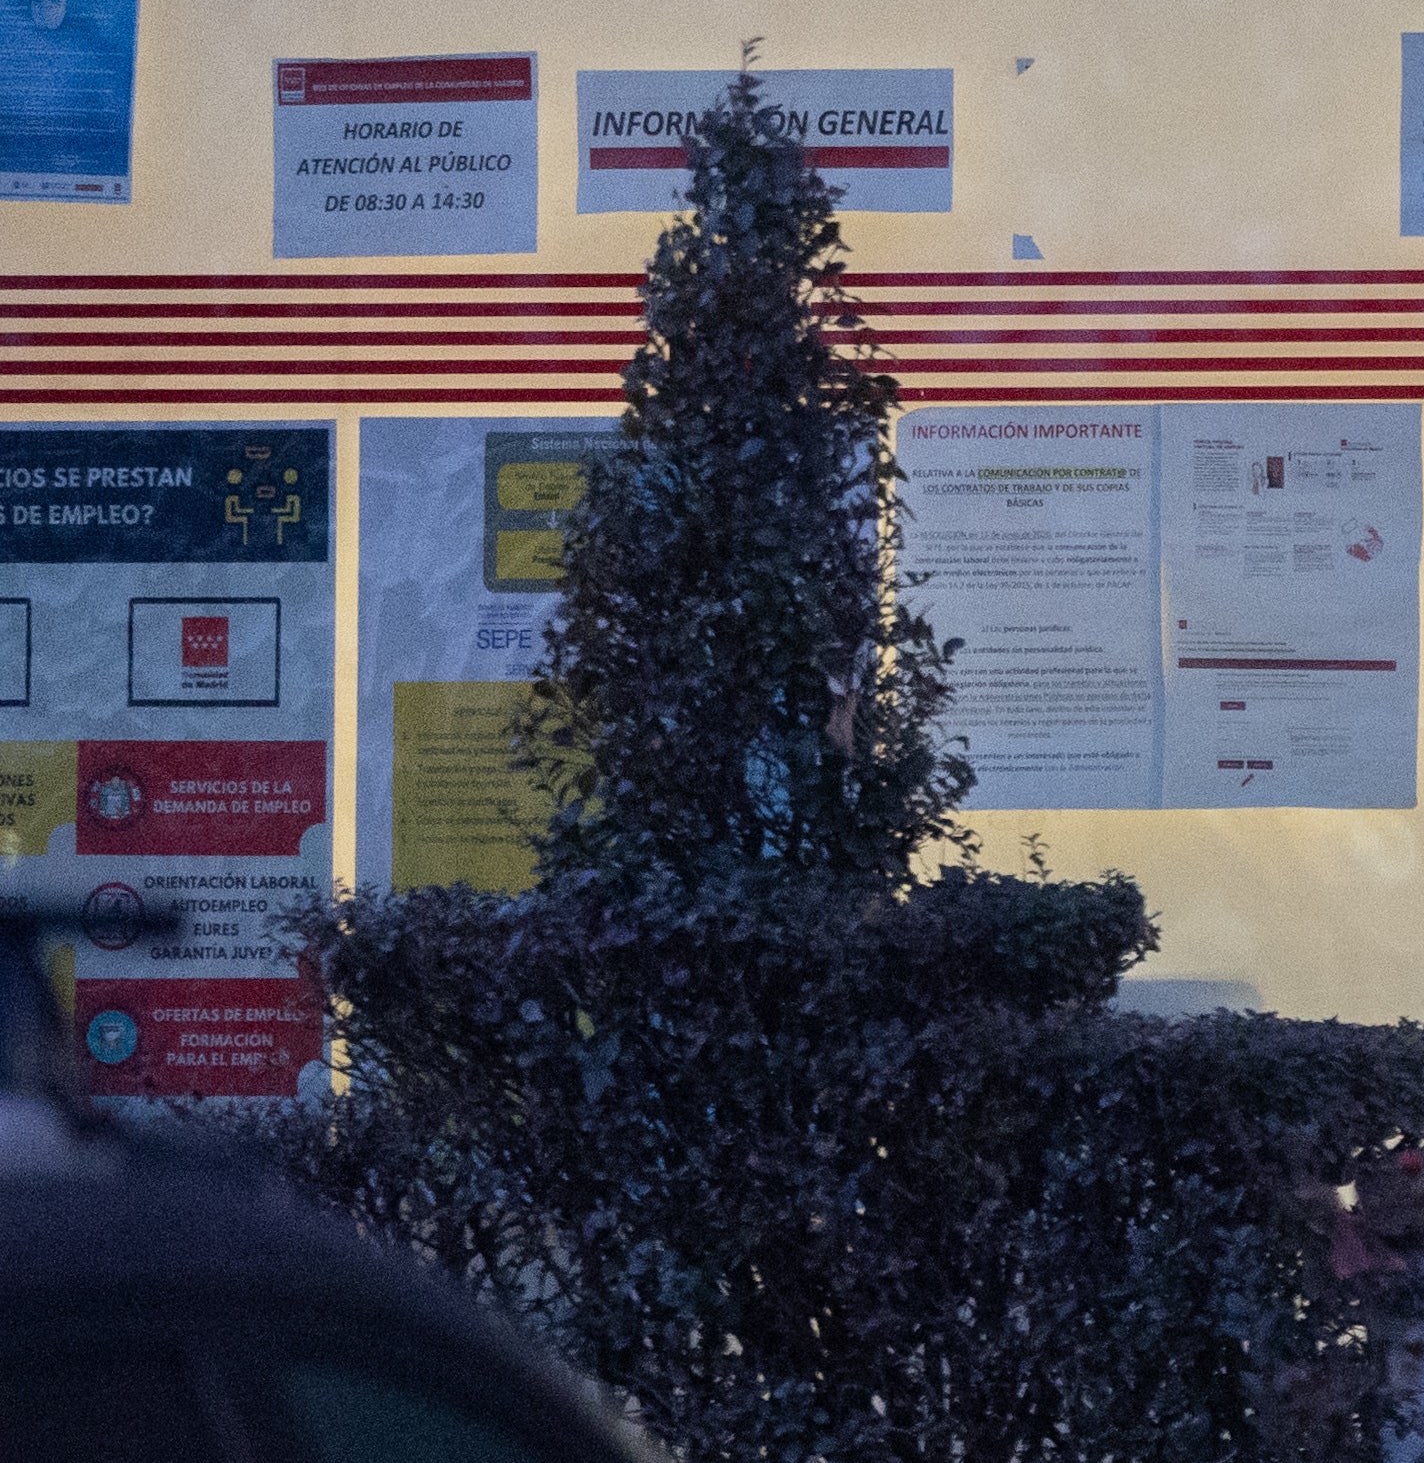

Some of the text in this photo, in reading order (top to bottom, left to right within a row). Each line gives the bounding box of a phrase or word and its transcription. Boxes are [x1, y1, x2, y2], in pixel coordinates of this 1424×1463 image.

[343, 120, 464, 141] HORARIO DE
[816, 109, 949, 136] GENERAL
[296, 151, 512, 176] ATENCIÓN AL PÚBLICO
[324, 191, 485, 213] DE 08:30 A 14:30
[911, 421, 1143, 440] INFORMACIÓN IMPORTANTE
[54, 467, 80, 488] SE
[87, 467, 192, 488] PRESTAN
[13, 504, 155, 525] DE EMPLEO?
[476, 629, 532, 649] SEPE
[169, 780, 293, 794] SERVICIOS DE LA
[153, 800, 312, 814] DEMANDA DE EMPLEO
[143, 872, 318, 890] ORIENTACIÓN LABORAL
[172, 899, 268, 913] AUTOEMPLEO
[194, 923, 240, 937] EURES
[152, 1009, 220, 1022] OFERTAS
[223, 1009, 242, 1022] DE
[181, 1031, 274, 1047] FORMACIÓN
[166, 1053, 228, 1066] PARA EL
